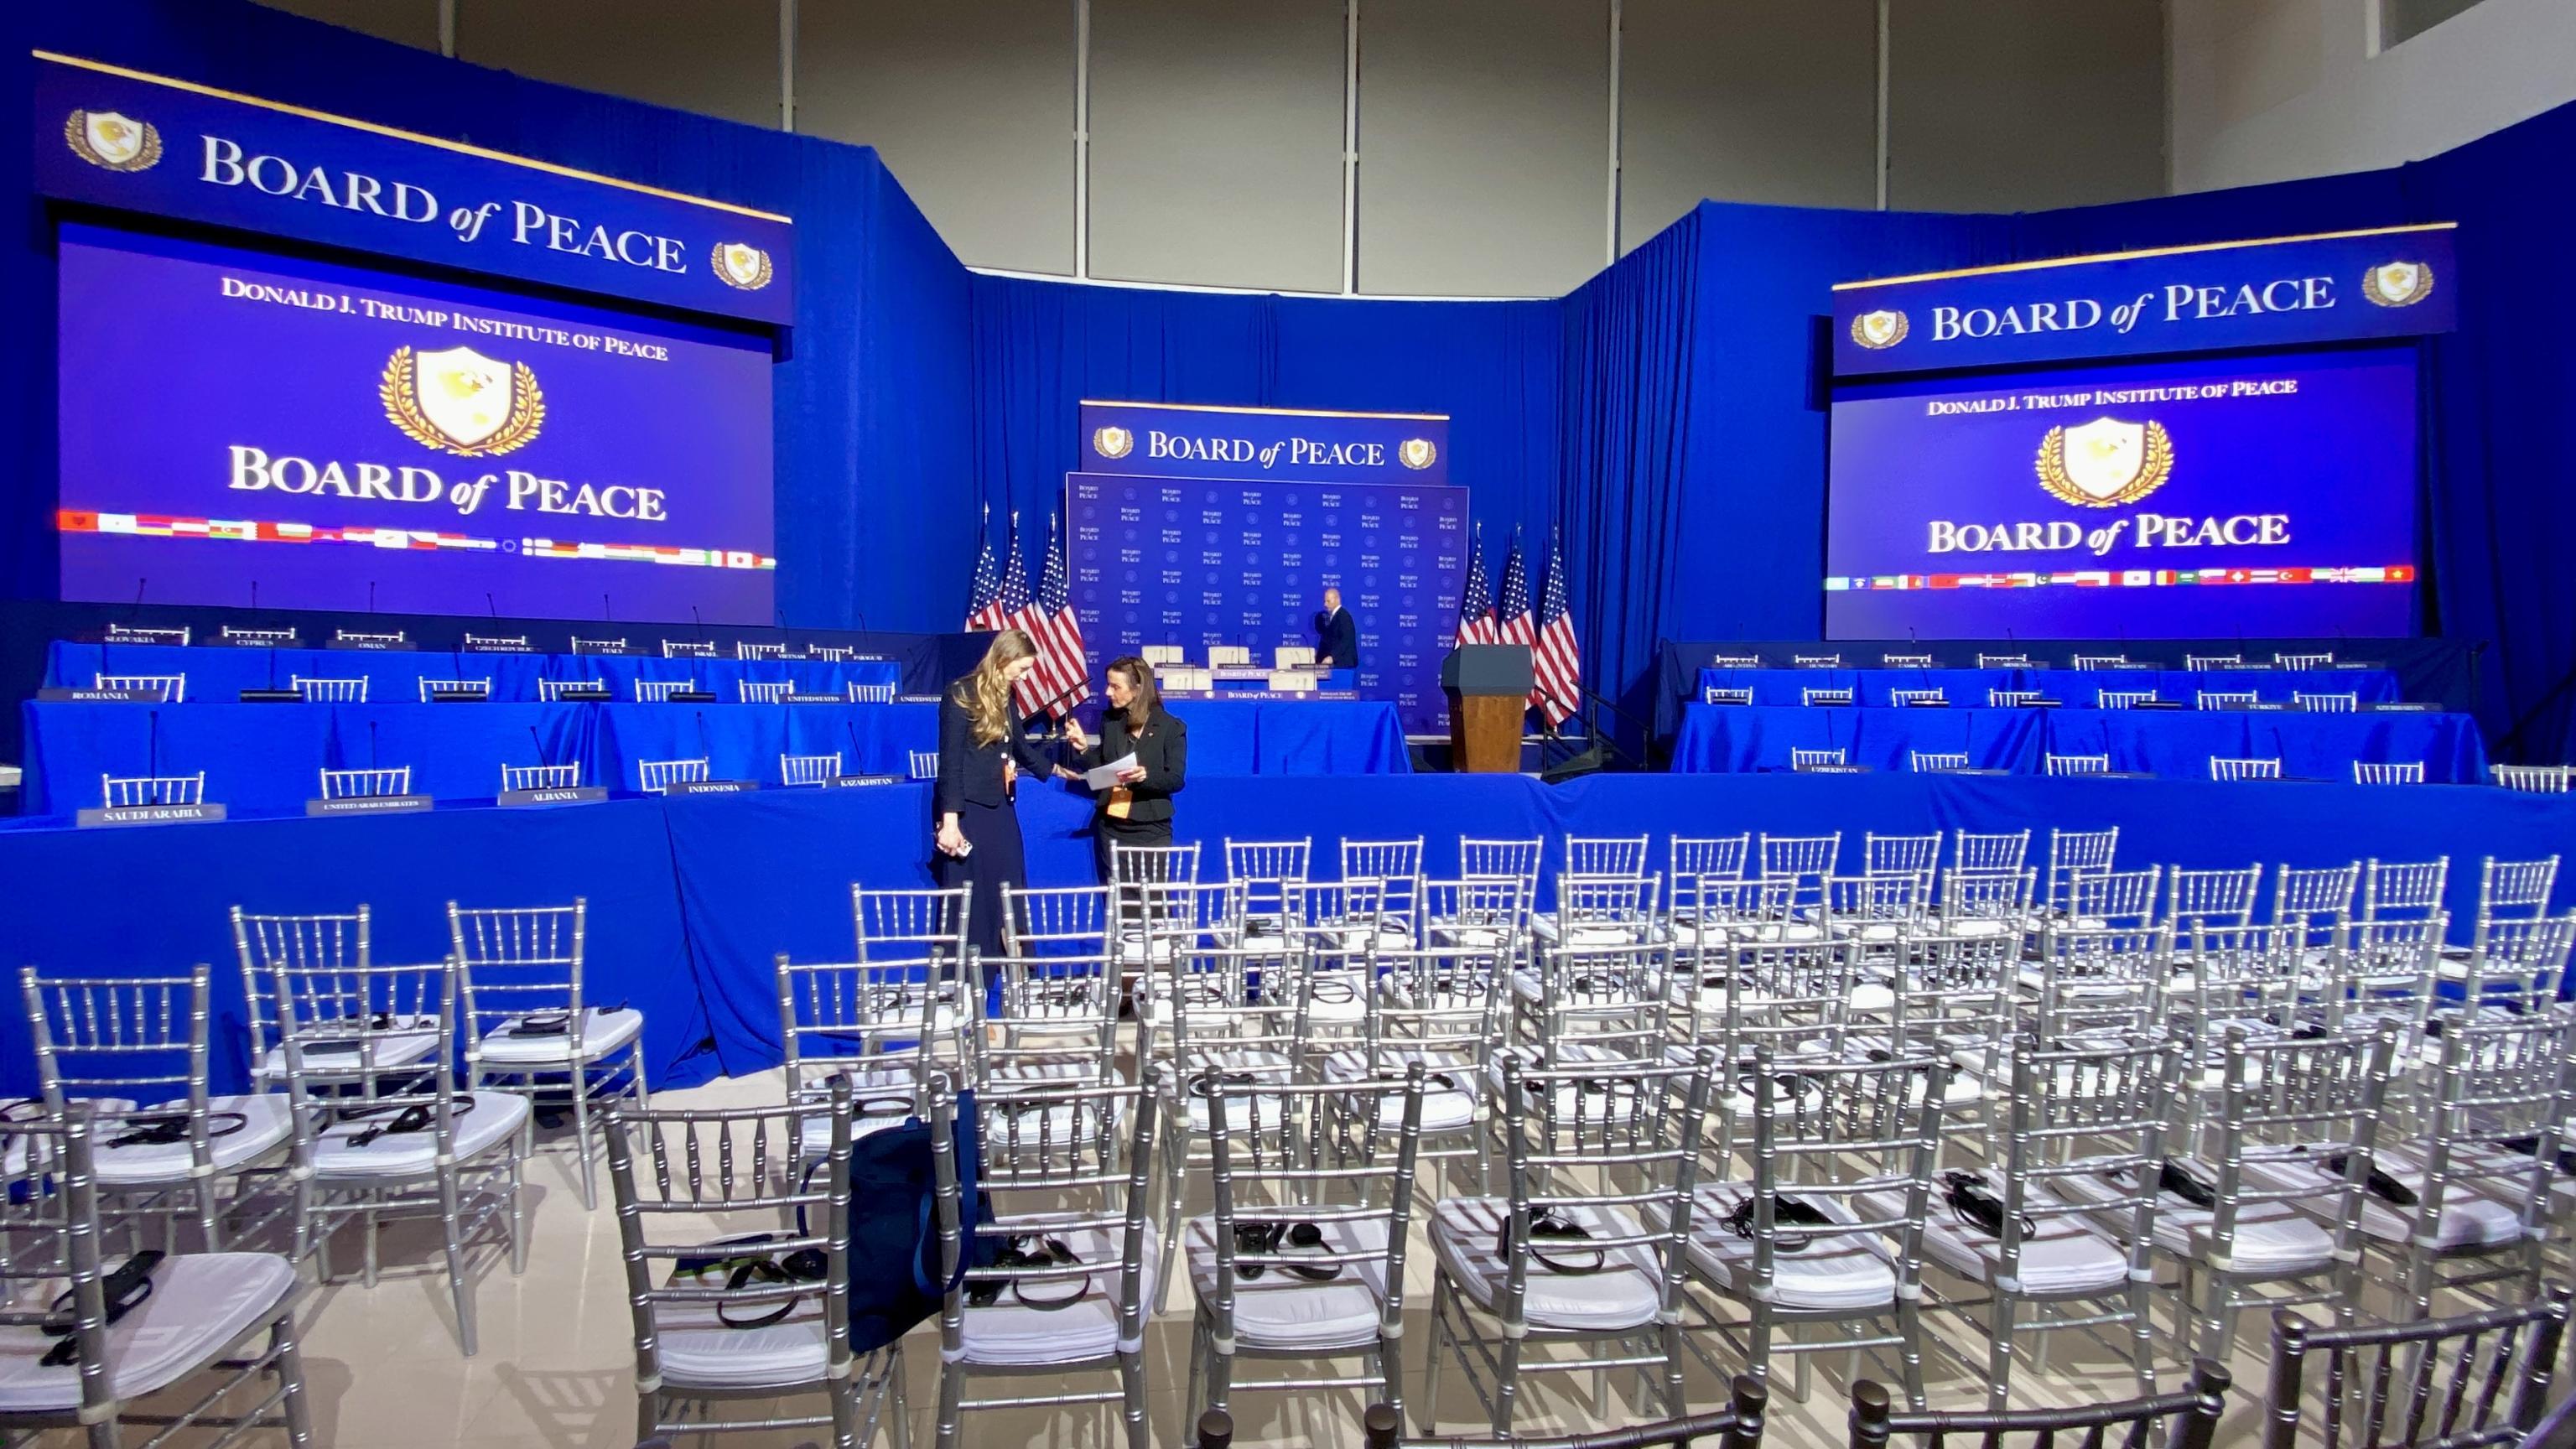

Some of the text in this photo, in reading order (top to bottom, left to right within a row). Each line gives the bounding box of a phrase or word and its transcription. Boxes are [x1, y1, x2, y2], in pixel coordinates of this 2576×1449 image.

[200, 135, 687, 274] BOARD of PEACE
[221, 277, 668, 361] DONALD J. TRUMP INSTITUTE OF PEACE
[1932, 277, 2336, 341] BOARD of PEACE
[1927, 380, 2298, 416] DONALD J. TRUMP INSTITUTE OF PEACE
[1148, 430, 1385, 470] BOARD of PEACE
[228, 445, 667, 522] BOARD of PEACE
[1927, 513, 2290, 557] BOARD of PEACE
[531, 792, 579, 802] ALBANIA
[688, 784, 740, 793] INDONESIA
[840, 777, 892, 787] KAZAKHSTAN
[103, 808, 202, 822] SAUDI ARABIA
